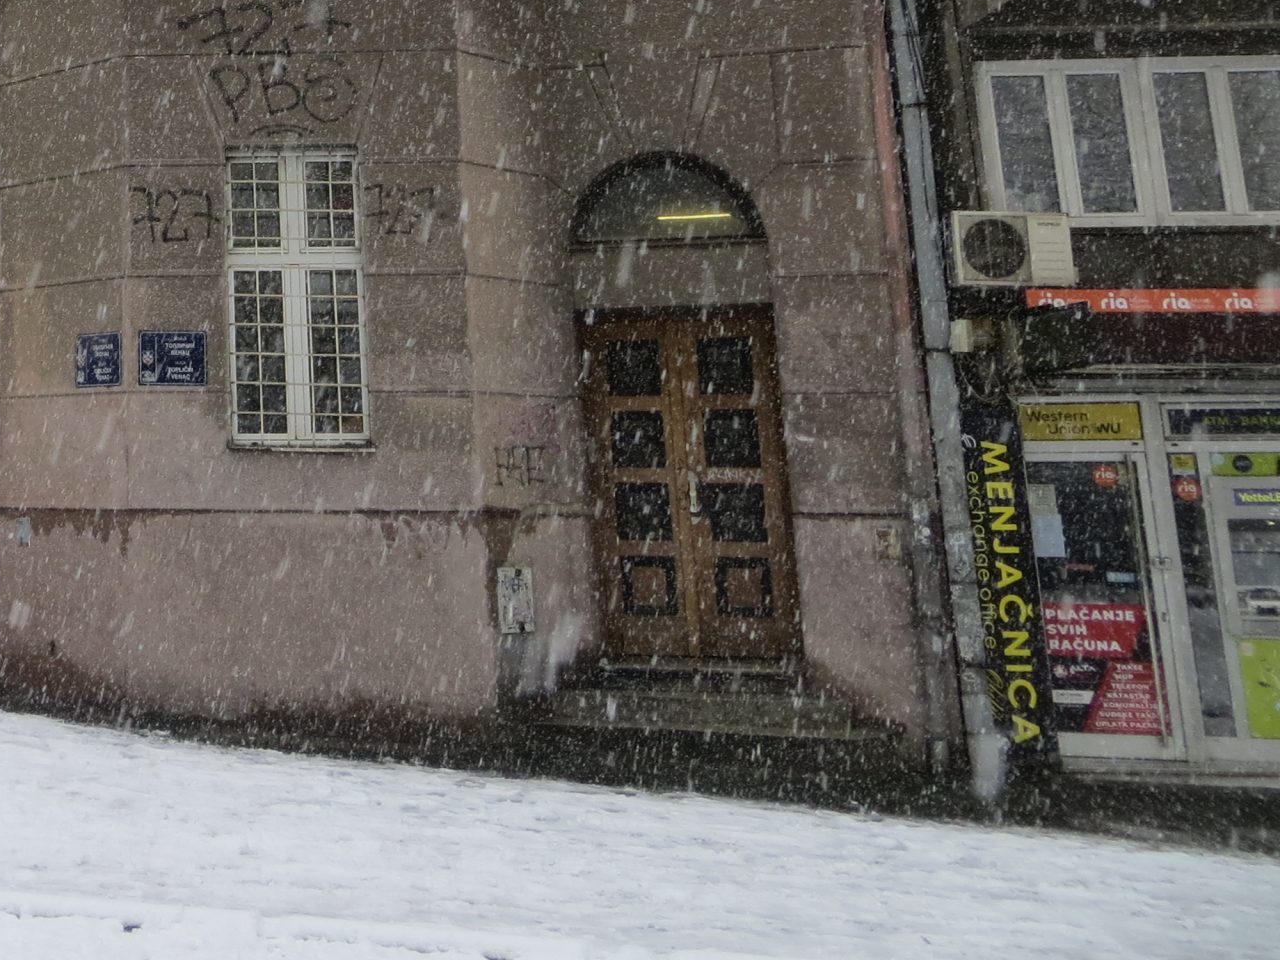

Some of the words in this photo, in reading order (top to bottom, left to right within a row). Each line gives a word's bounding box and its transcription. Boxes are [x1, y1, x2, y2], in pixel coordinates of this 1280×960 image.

[1101, 292, 1128, 309] ria
[1162, 292, 1191, 309] ria
[1225, 292, 1253, 309] ria
[1026, 411, 1089, 422] Western
[1047, 422, 1090, 434] Union
[1097, 422, 1121, 434] WU
[1095, 467, 1117, 479] ria
[1178, 481, 1197, 493] ria
[980, 441, 1041, 743] MENJAČNICA
[1045, 607, 1135, 622] PLAĆANJE
[1047, 624, 1088, 636] SVIH
[1049, 637, 1122, 652] RAČUNA
